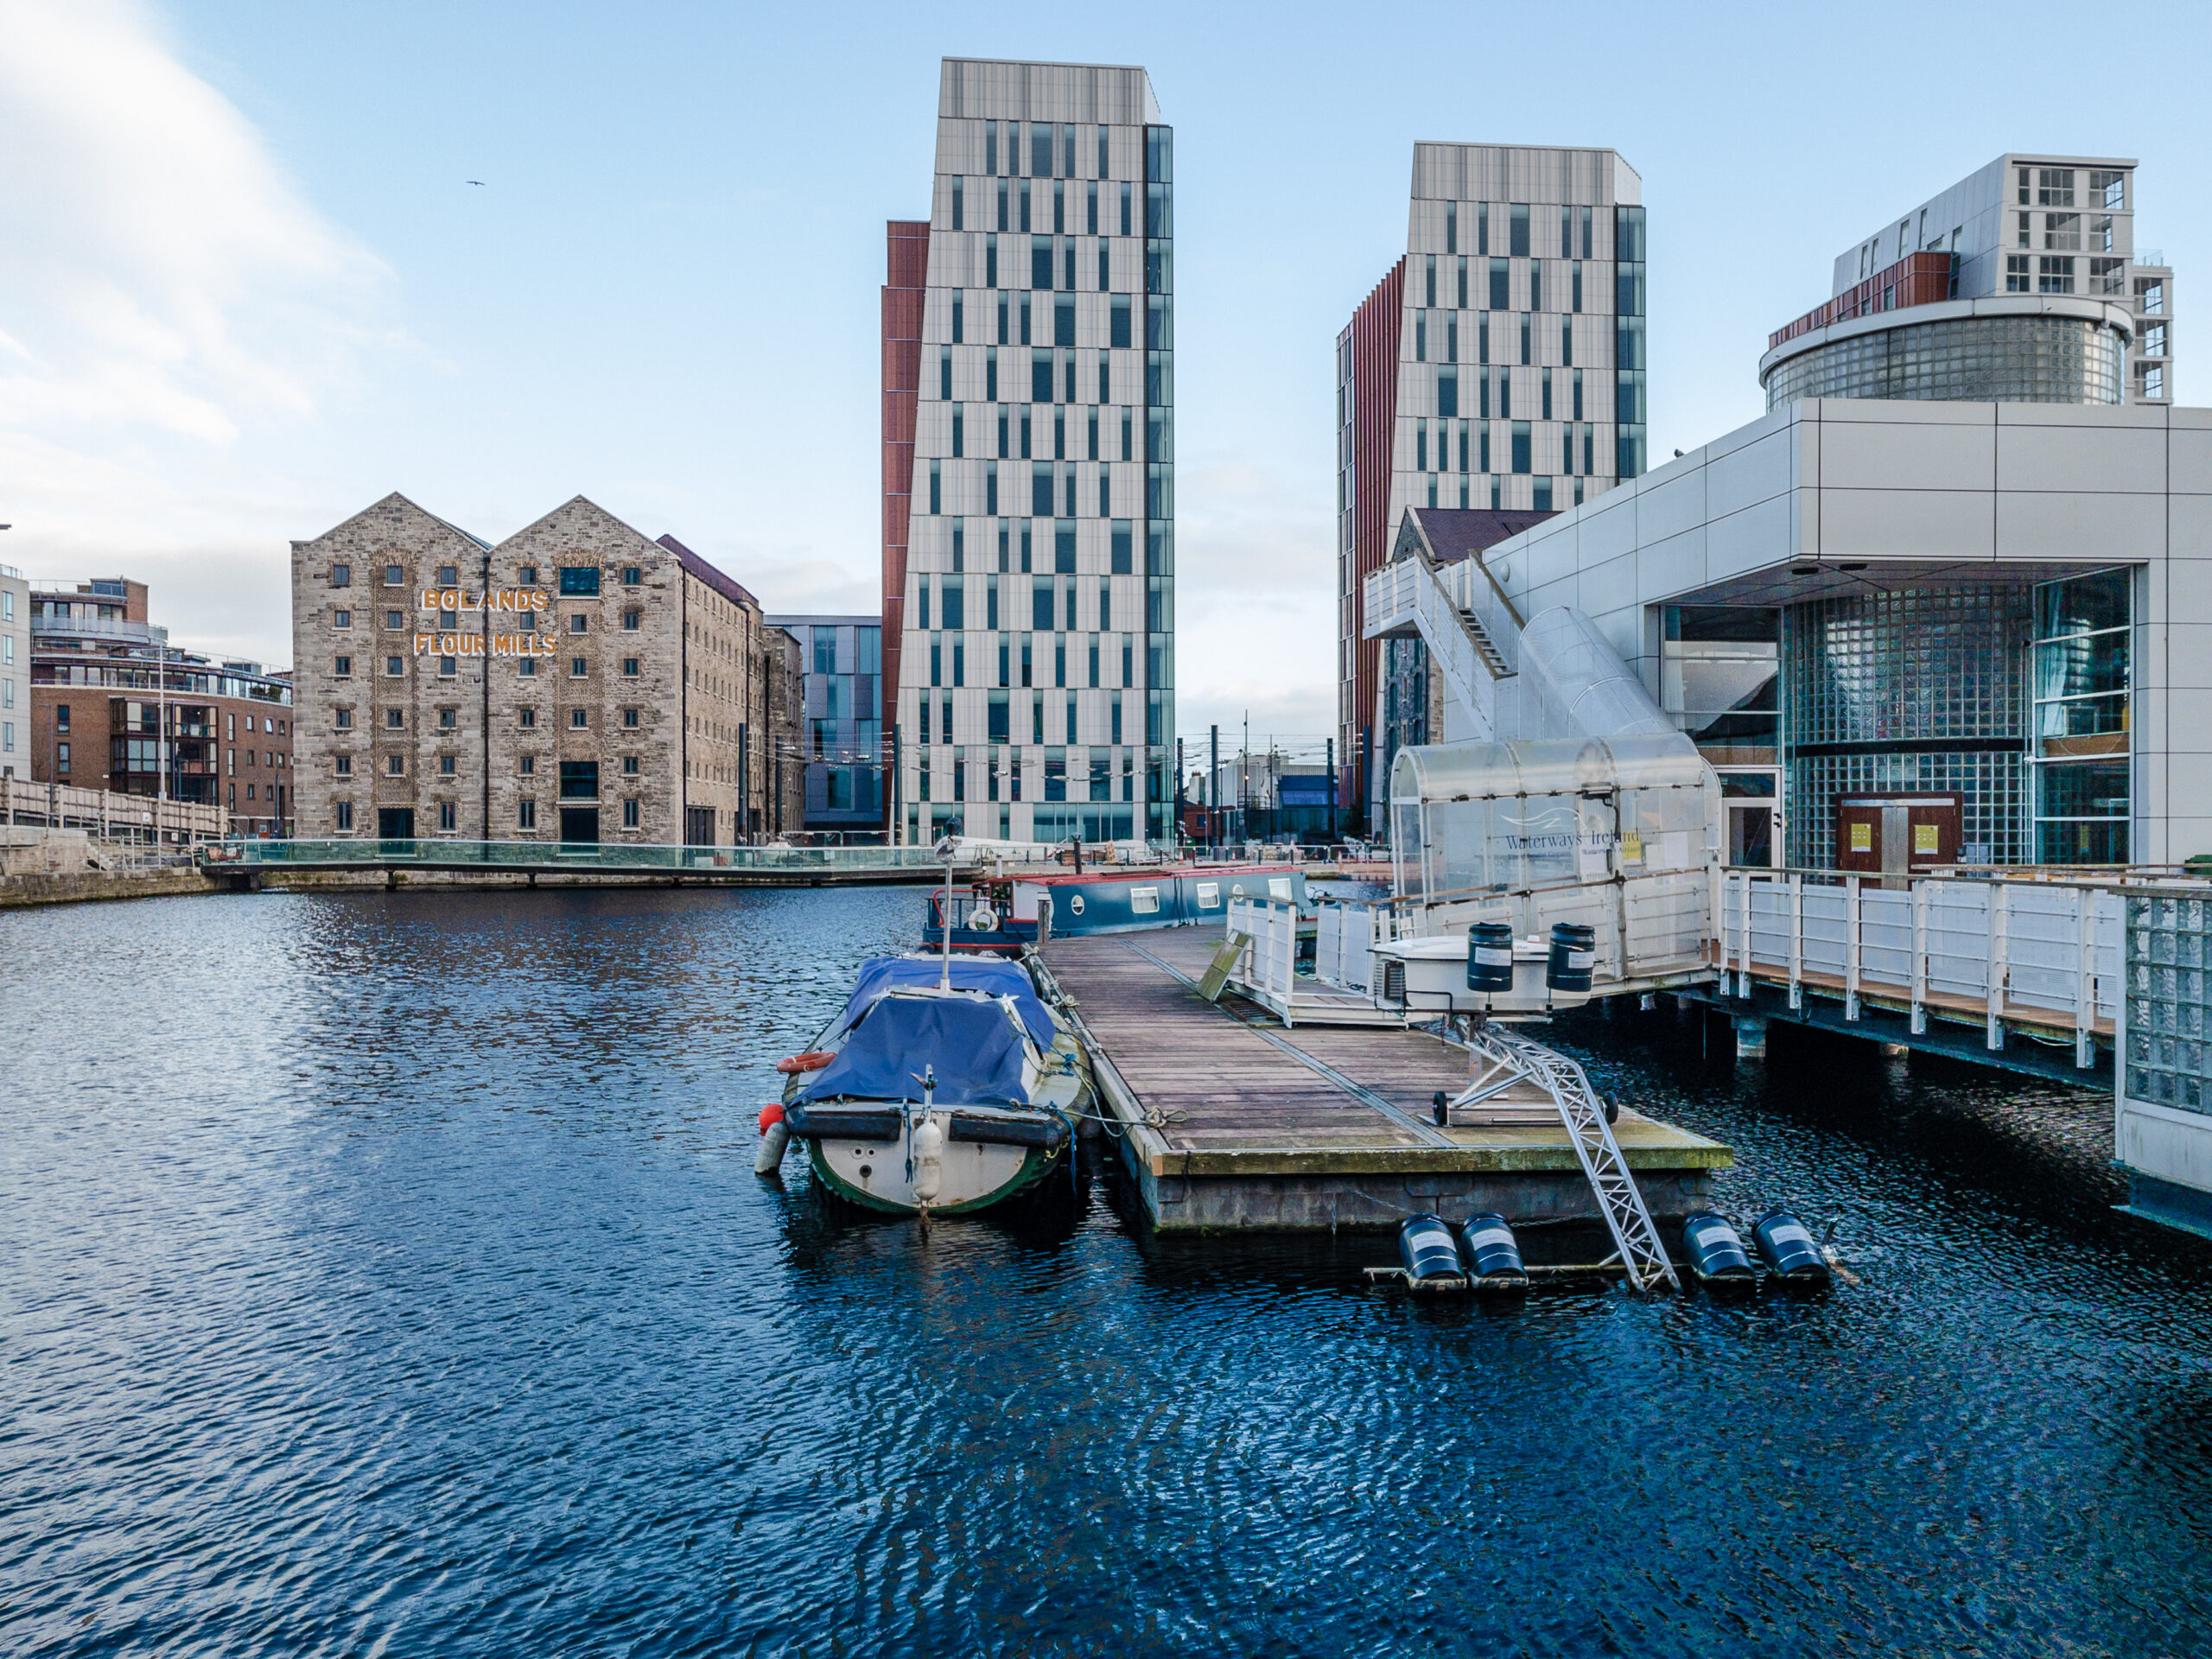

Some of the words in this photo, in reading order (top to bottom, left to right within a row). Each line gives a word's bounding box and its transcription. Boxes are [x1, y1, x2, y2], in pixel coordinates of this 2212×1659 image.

[422, 590, 548, 612] BOLANDS
[414, 633, 486, 657] FLOUR
[493, 633, 557, 658] MILLS
[1506, 833, 1582, 850] Waterways
